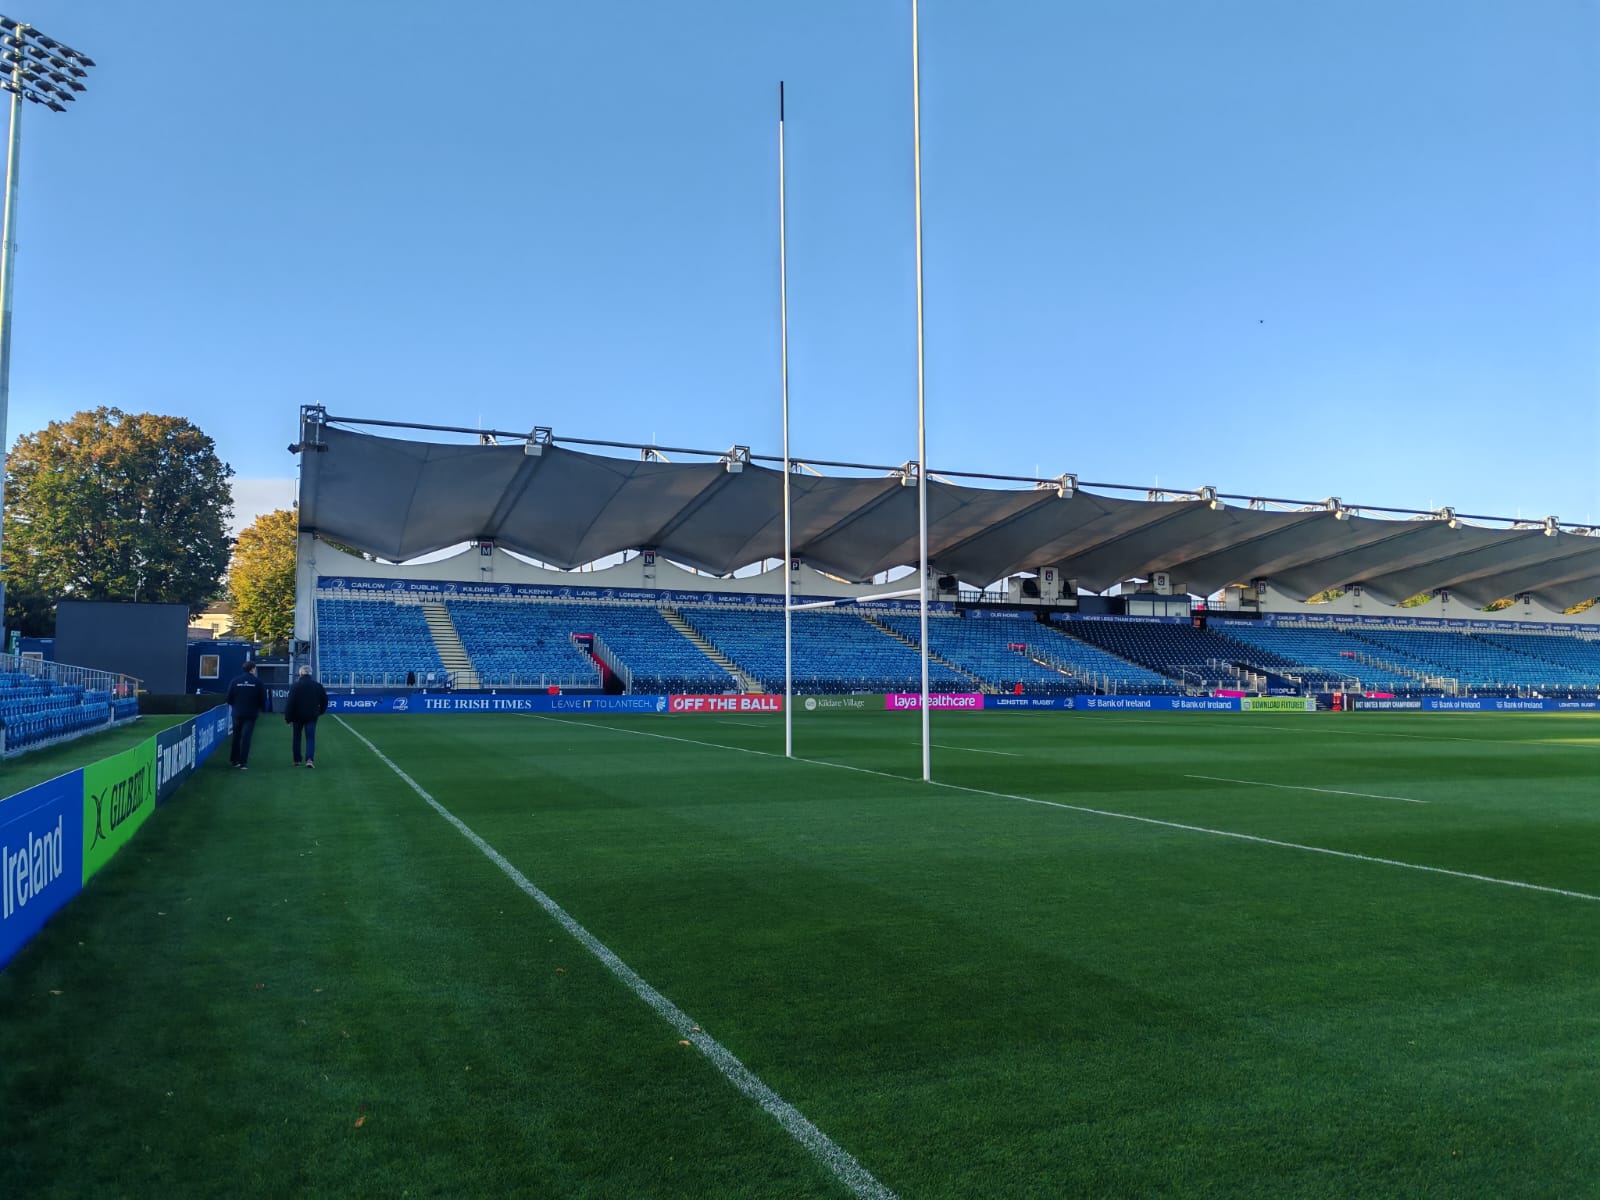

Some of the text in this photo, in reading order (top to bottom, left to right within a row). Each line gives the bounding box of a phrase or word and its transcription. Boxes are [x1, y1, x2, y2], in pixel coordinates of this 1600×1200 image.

[343, 700, 378, 708] RUGBY
[424, 698, 532, 710] THE IRISH TIMES
[551, 700, 581, 709] LEAVE
[583, 700, 592, 709] IT
[596, 700, 606, 708] TO
[673, 698, 778, 710] OFF THE BALL
[818, 699, 842, 707] Kildare
[843, 698, 865, 709] Village
[894, 694, 917, 709] laya
[1097, 698, 1151, 708] Bank of Ireland
[1180, 700, 1232, 709] Bank of Ireland
[1440, 701, 1453, 709] Bank
[1461, 701, 1481, 709] Ireland
[1504, 701, 1518, 709] Bank
[1524, 701, 1543, 709] Ireland
[110, 766, 146, 831] GILBERT
[3, 814, 62, 920] Ireland
